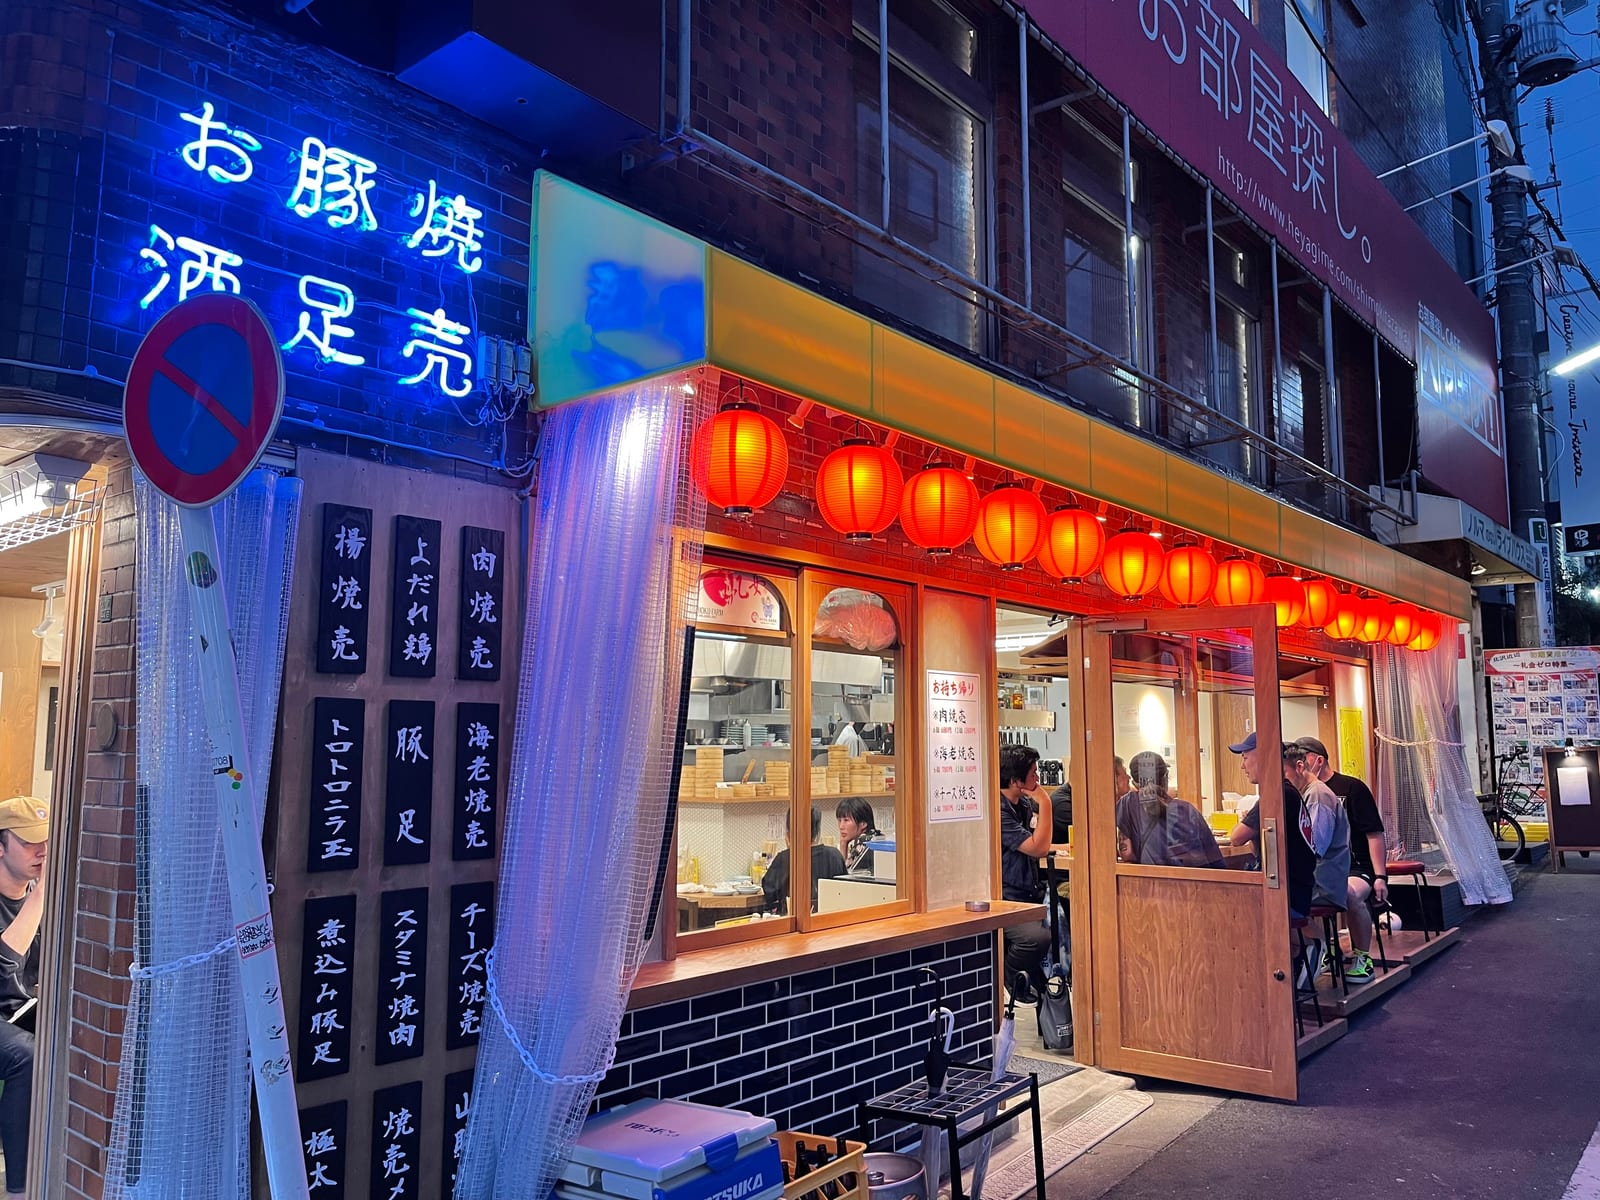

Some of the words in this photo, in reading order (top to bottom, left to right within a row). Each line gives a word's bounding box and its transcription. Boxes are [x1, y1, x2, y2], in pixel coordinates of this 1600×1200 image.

[403, 537, 435, 667] よだれ鶏
[469, 547, 498, 669] 肉焼売
[932, 680, 975, 697] お持ち帰り
[321, 719, 353, 860] トロトロニラ玉
[465, 722, 494, 849] 海老焼売
[309, 919, 347, 1066] 煮込み豚足
[388, 909, 419, 1047] スタミナ焼肉
[459, 903, 488, 1037] チーズ焼売
